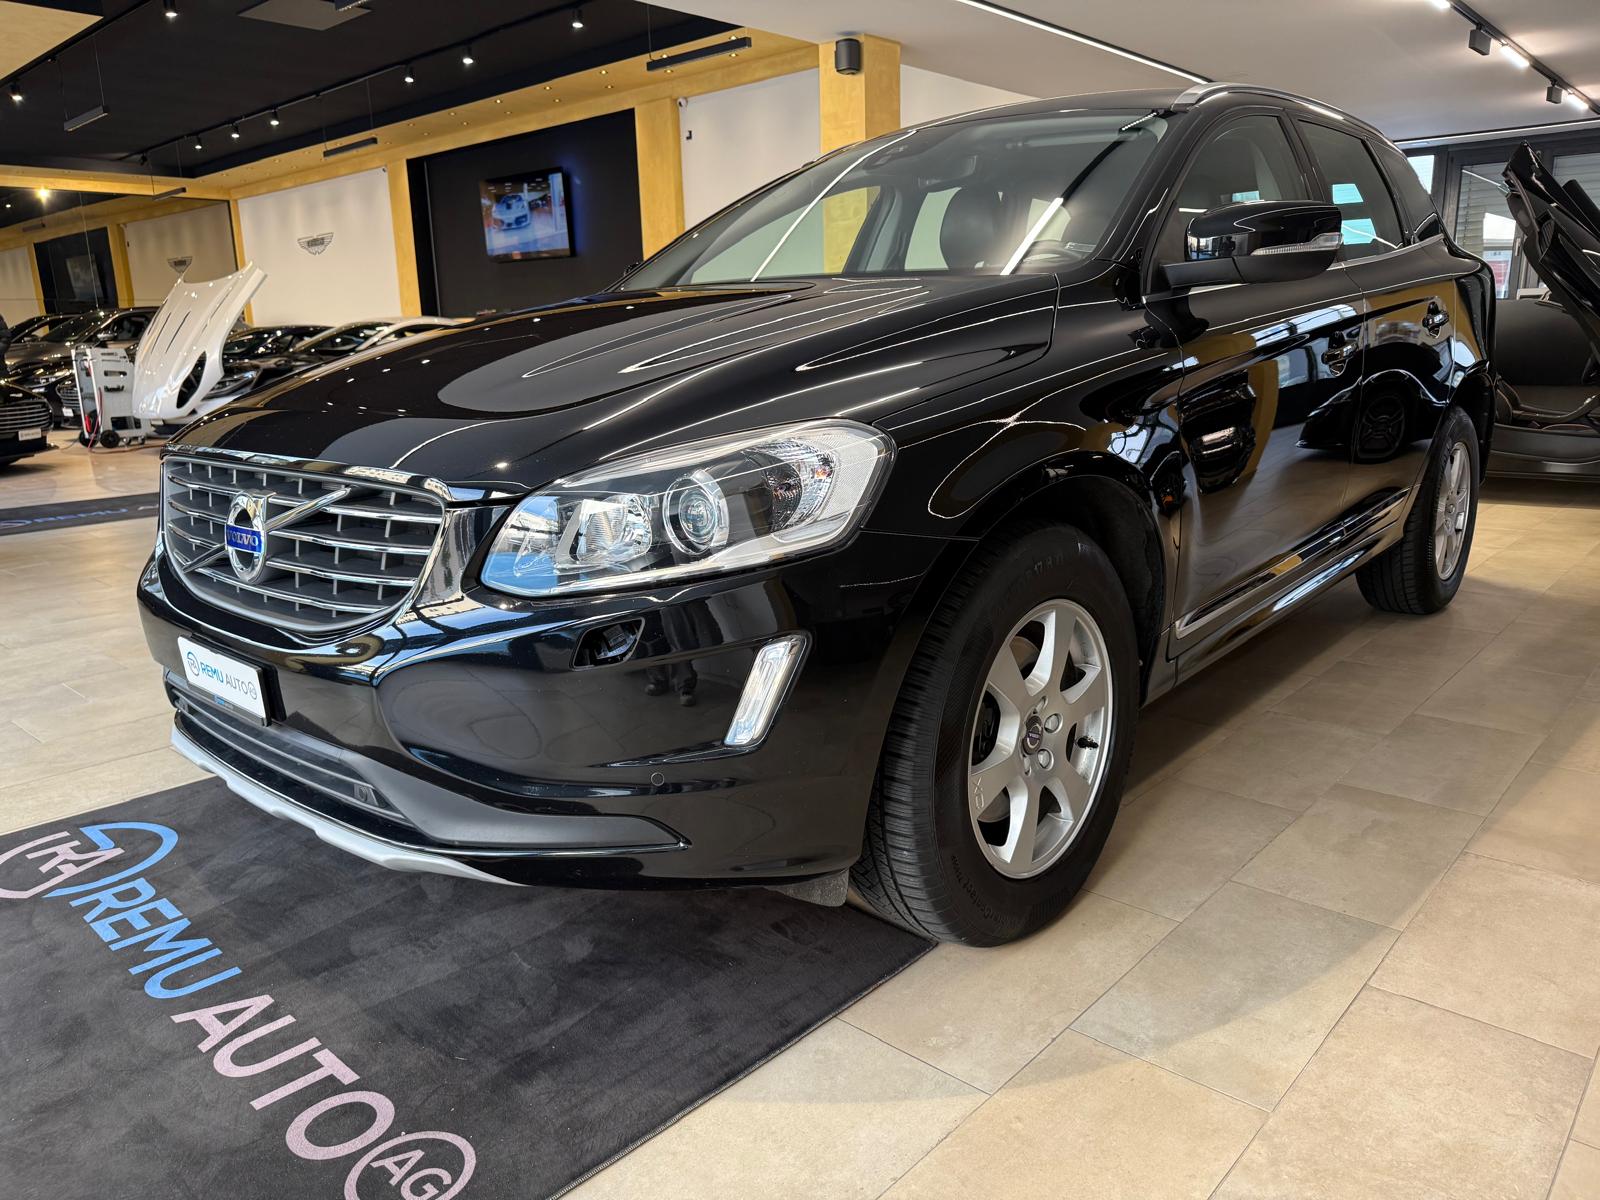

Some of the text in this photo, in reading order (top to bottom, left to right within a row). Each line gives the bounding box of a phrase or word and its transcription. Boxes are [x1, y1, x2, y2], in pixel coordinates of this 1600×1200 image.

[226, 528, 259, 547] VOLVO
[200, 661, 224, 684] REMU
[225, 673, 249, 695] AUTO
[69, 877, 453, 1200] REMU AUTO AG
